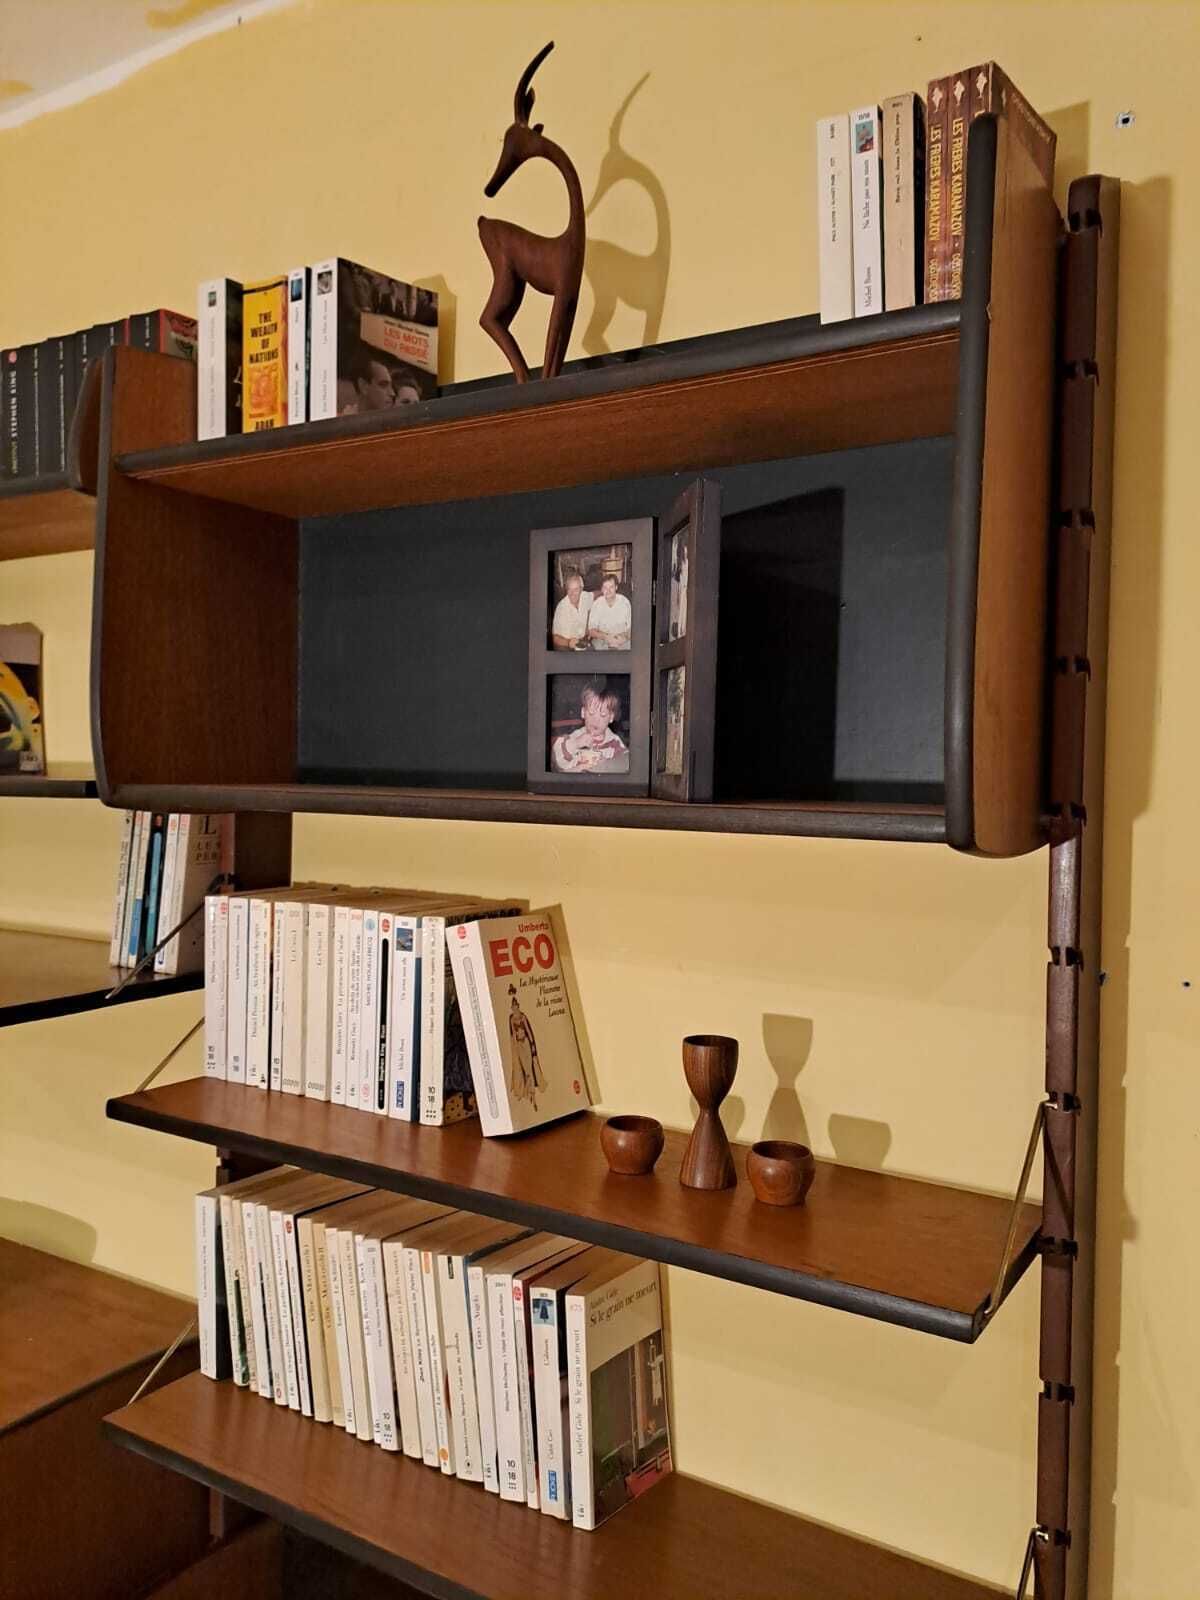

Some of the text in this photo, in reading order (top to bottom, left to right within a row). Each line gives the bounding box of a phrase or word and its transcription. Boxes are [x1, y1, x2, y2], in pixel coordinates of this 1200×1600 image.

[930, 125, 941, 141] LES
[952, 117, 963, 136] LES
[929, 143, 941, 178] FRERES
[952, 138, 963, 173] FRERES
[928, 179, 940, 241] KARAMAZOV
[951, 174, 963, 236] KARAMAZOV
[864, 284, 872, 308] Michel
[258, 311, 272, 323] THE
[250, 322, 278, 338] WEALTH
[383, 326, 400, 340] LES
[402, 332, 429, 348] MOTS
[261, 338, 270, 350] OF
[249, 347, 279, 364] NATIONS
[255, 418, 274, 431] ADAM
[518, 922, 549, 933] Umberto
[489, 933, 555, 978] ECO
[377, 1057, 385, 1082] Stephen
[428, 1086, 436, 1094] 10
[574, 1353, 581, 1365] ne
[573, 1366, 583, 1387] grain
[575, 1431, 583, 1456] André
[507, 1460, 516, 1468] 10
[508, 1472, 516, 1480] 18
